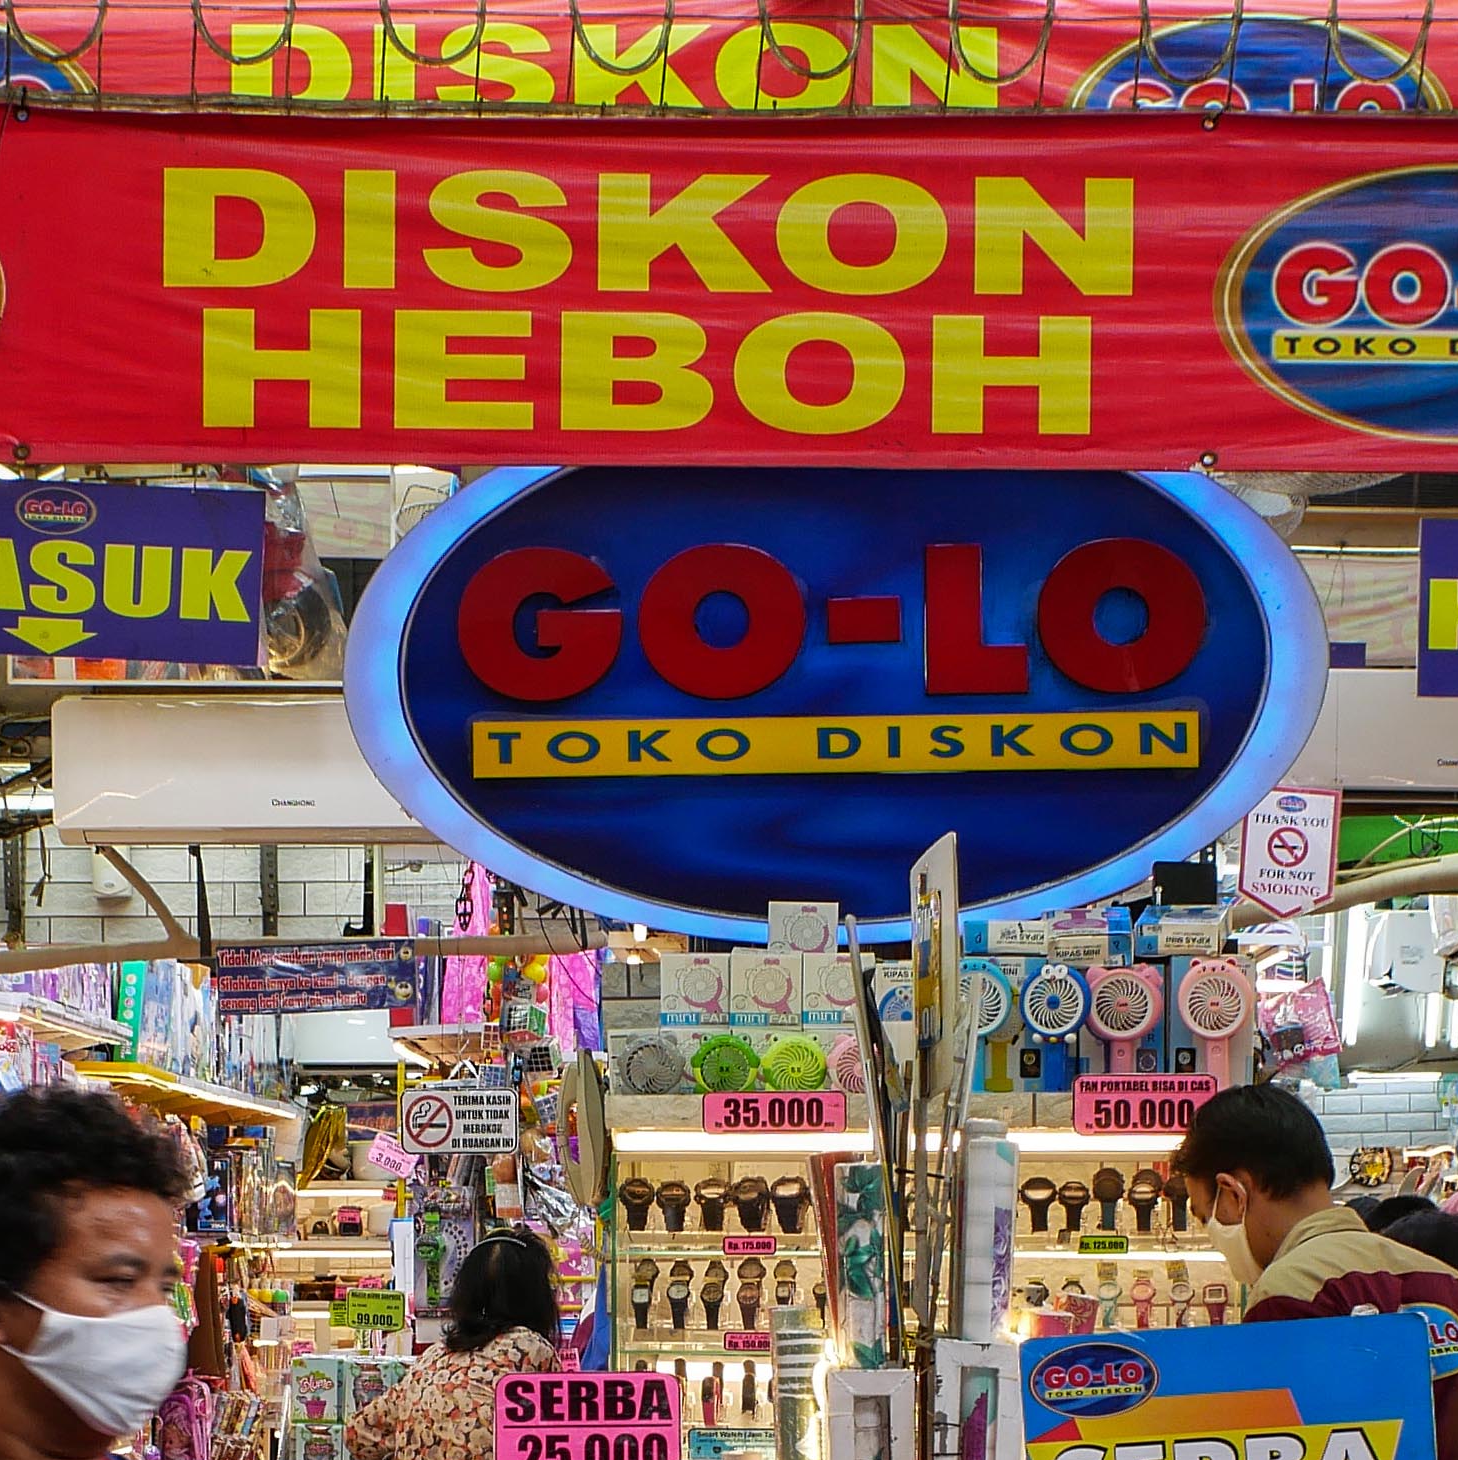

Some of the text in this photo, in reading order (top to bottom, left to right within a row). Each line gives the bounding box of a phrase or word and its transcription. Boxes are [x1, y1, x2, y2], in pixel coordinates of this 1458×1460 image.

[230, 22, 1000, 109] DISKON
[163, 167, 1134, 297] DISKON
[1283, 335, 1417, 357] TOKO
[202, 307, 1092, 436] HEBOH
[24, 499, 88, 516] GO-LO
[457, 536, 1209, 701] GO-LO
[487, 721, 1189, 765] TOKO DISKON
[1254, 812, 1329, 828] THANK YOU
[1259, 867, 1316, 882] FOR NOT
[1251, 881, 1321, 898] SMOKING
[217, 949, 248, 967] Tidak
[1056, 949, 1083, 959] KIPAS
[1080, 1080, 1211, 1092] FAN PORTABEL BISA DI CAS
[453, 1094, 512, 1106] TERIMA KASIH
[455, 1109, 510, 1120] UNTUK TIDAK
[723, 1097, 824, 1128] 35.000
[1094, 1098, 1195, 1129] 50.000
[462, 1123, 503, 1134] MEROKOK
[451, 1137, 514, 1149] DI RUANGAN INI
[375, 1152, 403, 1172] 3.000
[727, 1240, 772, 1250] Rp. 175.000
[355, 1312, 393, 1328] 99.000
[728, 1340, 740, 1349] Rp.
[1042, 1360, 1145, 1390] GO-LO
[503, 1378, 673, 1424] SERBA
[1047, 1386, 1142, 1399] TOKO DISKON
